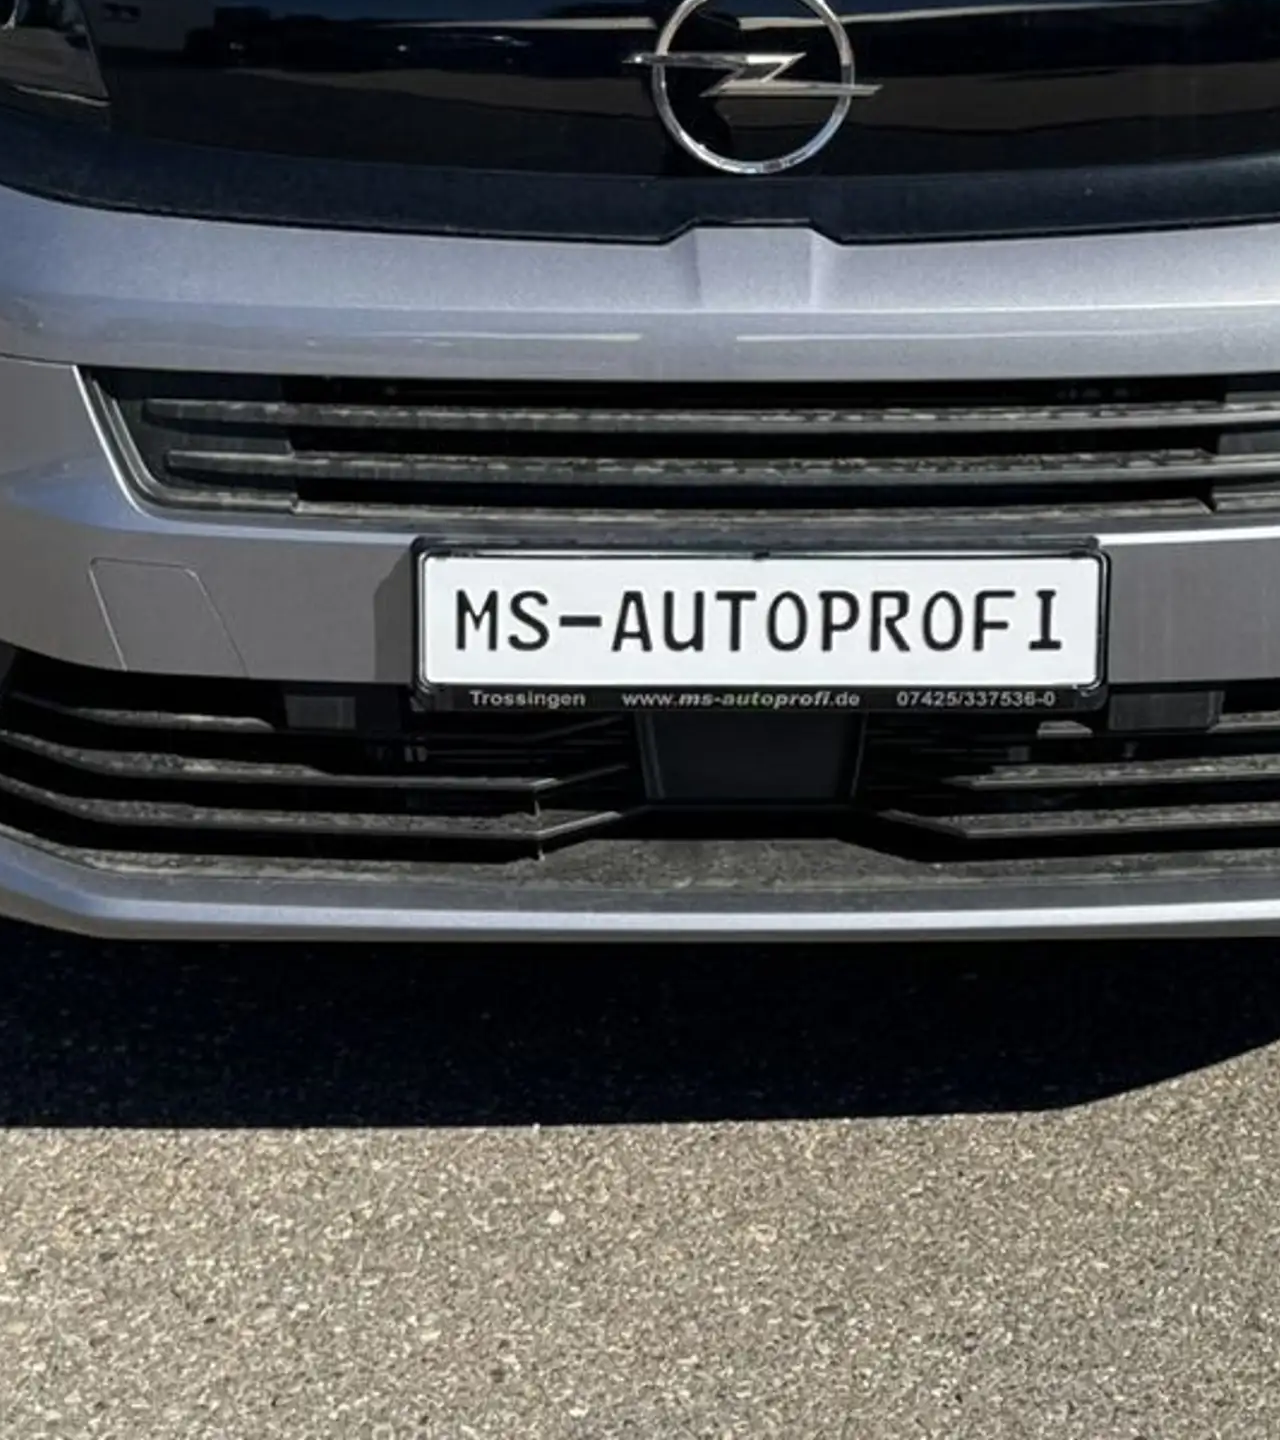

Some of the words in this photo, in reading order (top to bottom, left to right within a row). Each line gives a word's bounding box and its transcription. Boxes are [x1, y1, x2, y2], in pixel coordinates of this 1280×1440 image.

[455, 589, 1062, 652] MS-AUTOPROFI
[469, 689, 586, 709] Trossingen
[621, 690, 861, 710] www.ms-autoprofi.de
